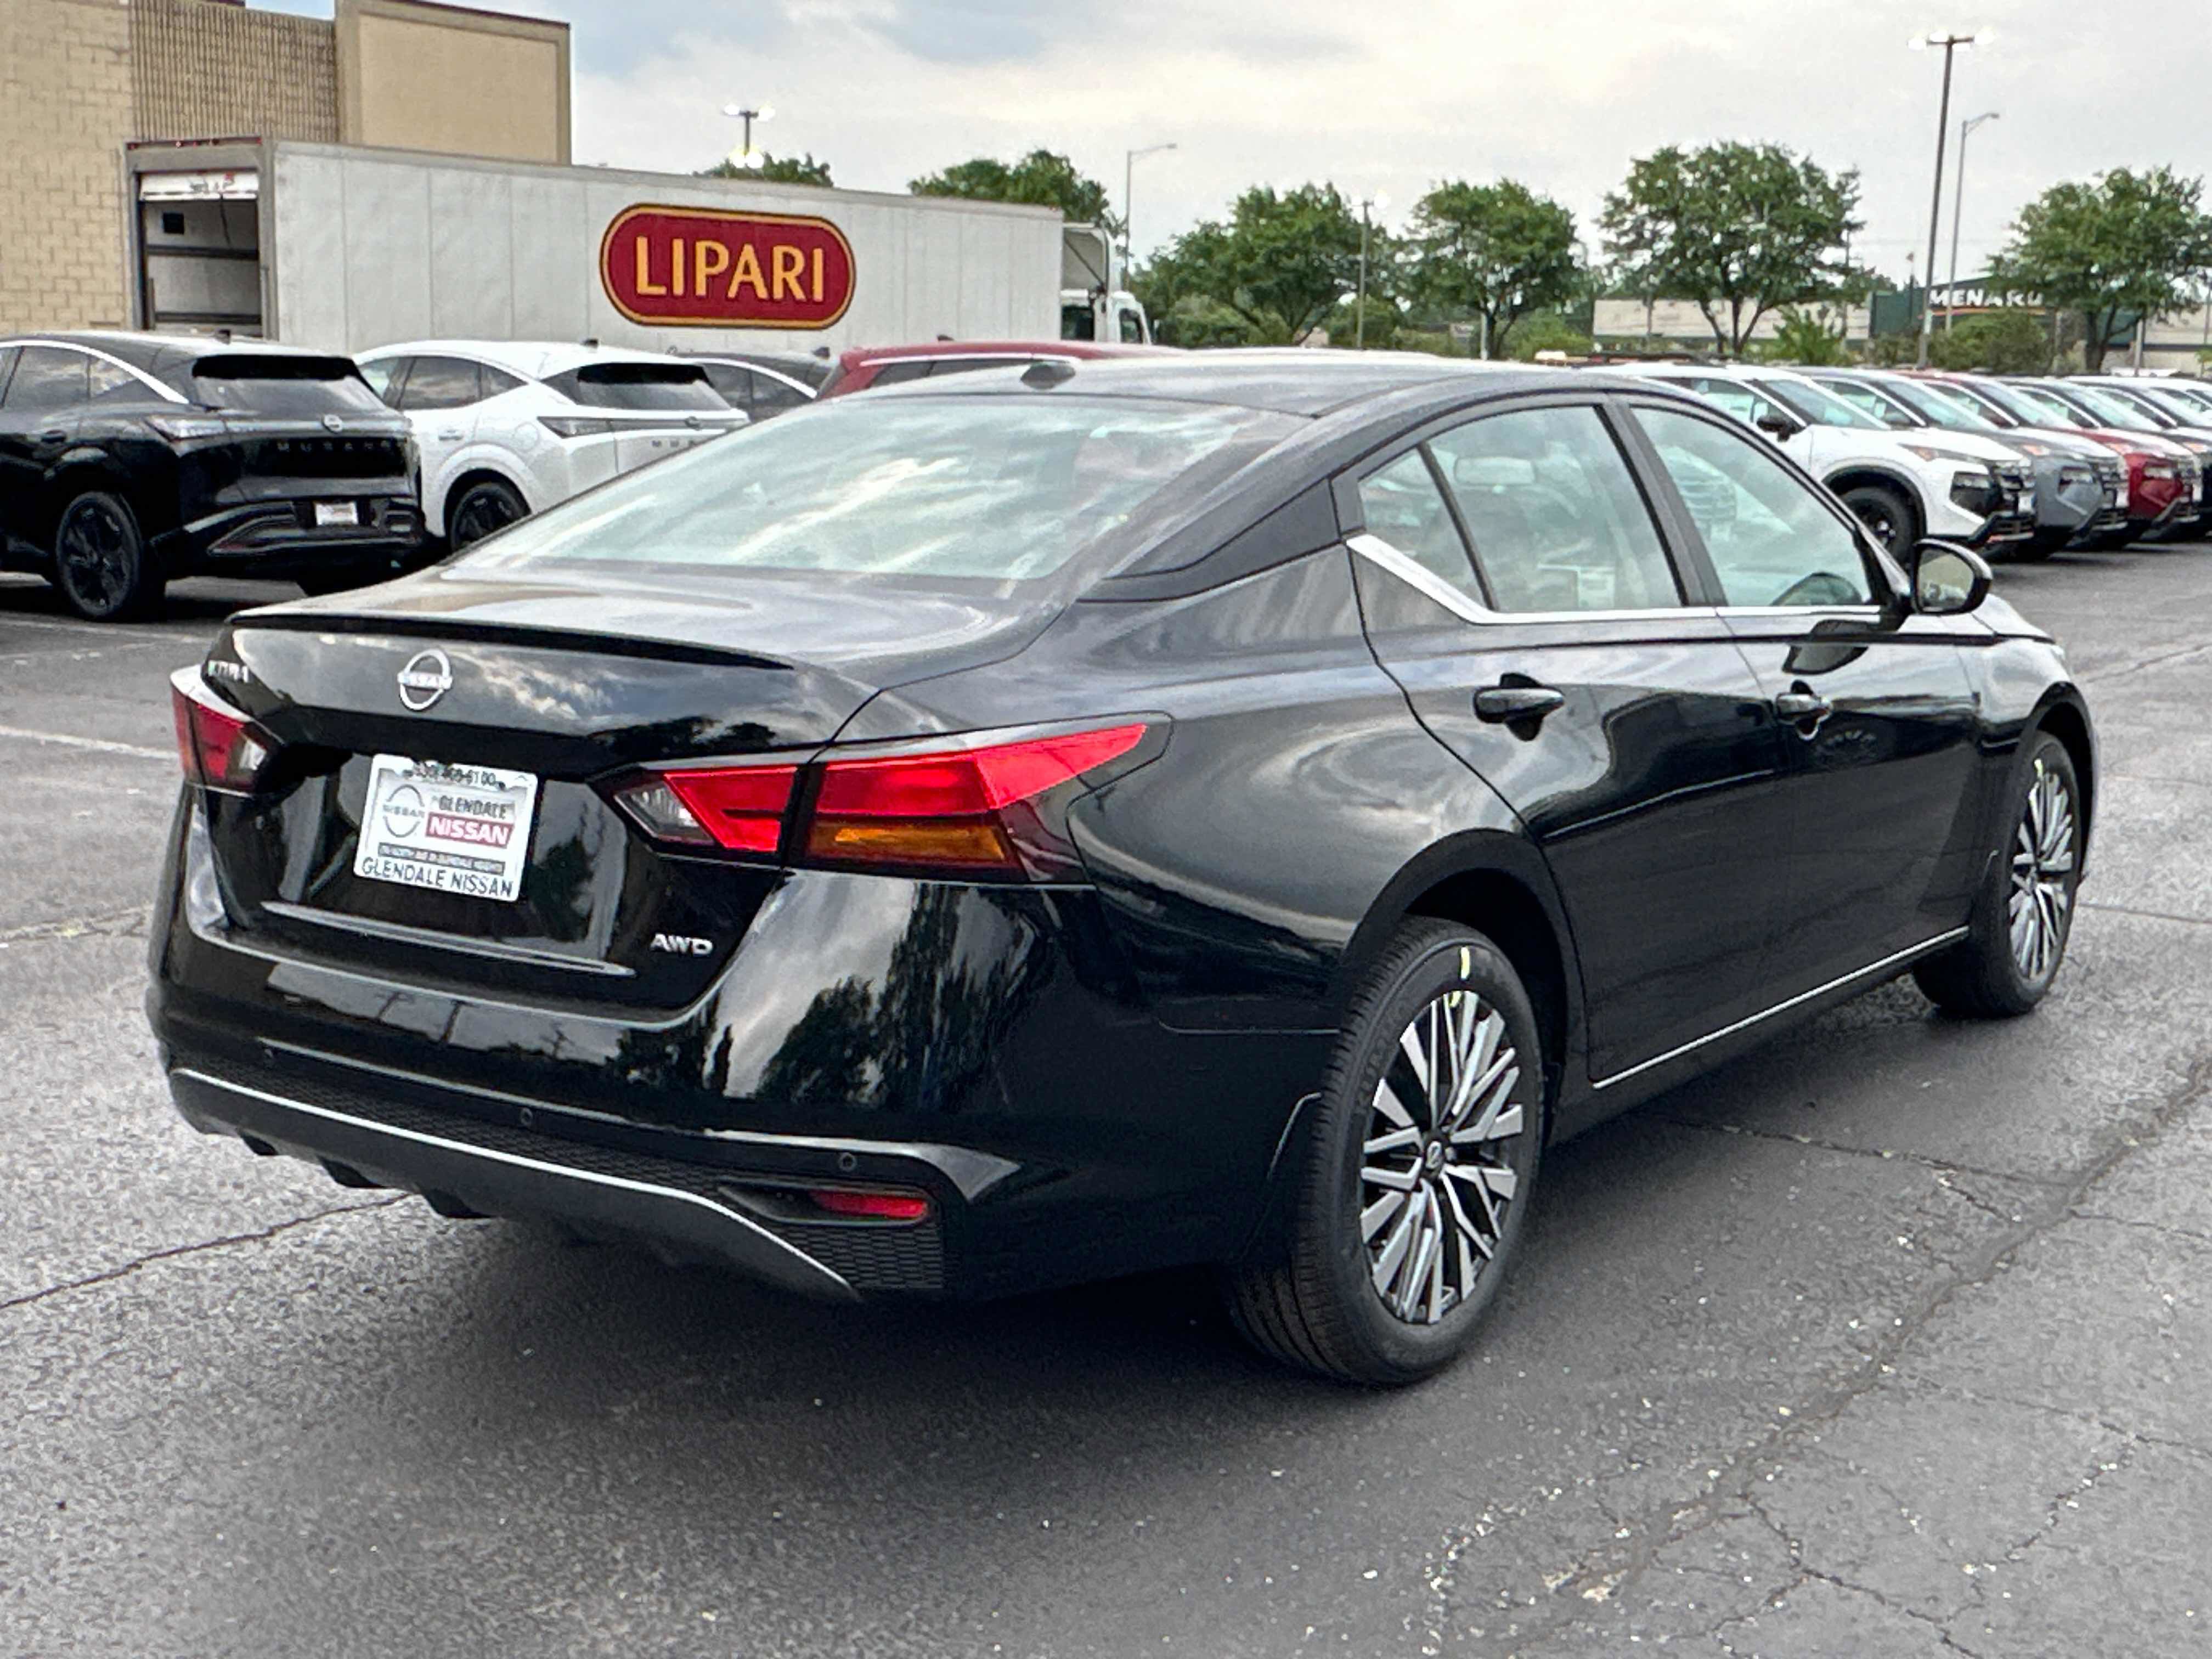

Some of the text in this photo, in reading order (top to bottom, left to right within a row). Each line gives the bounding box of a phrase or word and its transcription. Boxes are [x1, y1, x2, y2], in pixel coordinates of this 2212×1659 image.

[635, 235, 825, 302] LIPARI
[438, 794, 506, 820] GLENDALE
[429, 815, 509, 845] NISSAN
[362, 856, 447, 888] GLENDALE
[449, 871, 514, 898] NISSAN
[650, 932, 714, 956] AWD
